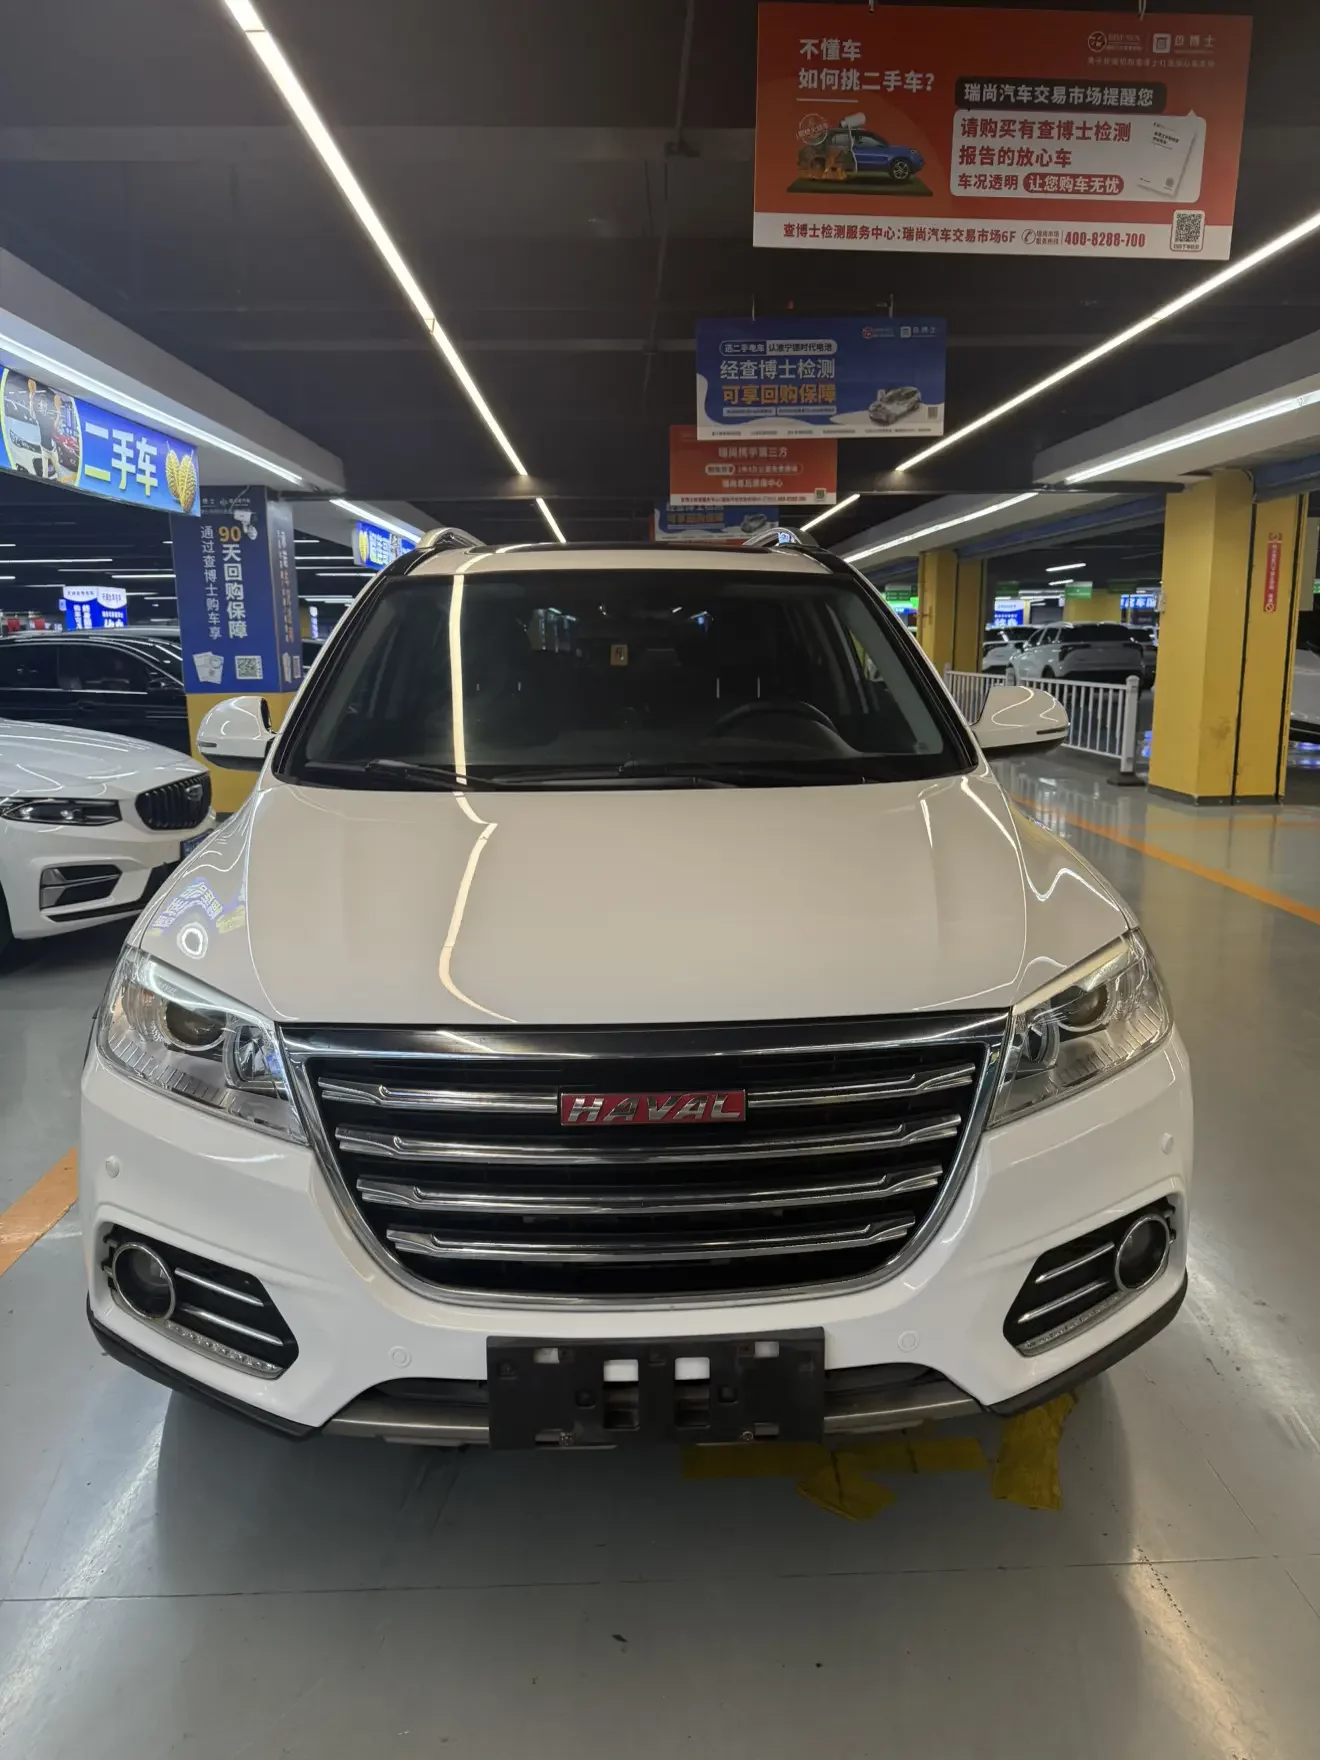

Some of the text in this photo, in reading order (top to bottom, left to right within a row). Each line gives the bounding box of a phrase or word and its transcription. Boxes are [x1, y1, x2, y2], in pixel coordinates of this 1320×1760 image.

[799, 37, 862, 62] 不懂车
[964, 83, 1154, 107] 瑞尚汽车交易市场提醒您
[961, 118, 1132, 143] 请购买有查博士检测
[959, 145, 1072, 168] 报告的放心车
[957, 173, 1120, 194] 车况透明 让您购车无忧
[1064, 231, 1146, 248] 400-8288-700
[719, 358, 836, 380] 经查博士检测
[721, 383, 837, 405] 可享回购保障
[84, 421, 159, 496] 二手车
[200, 526, 222, 640] 通过查博士购车享
[567, 1094, 741, 1123] HAVAL
